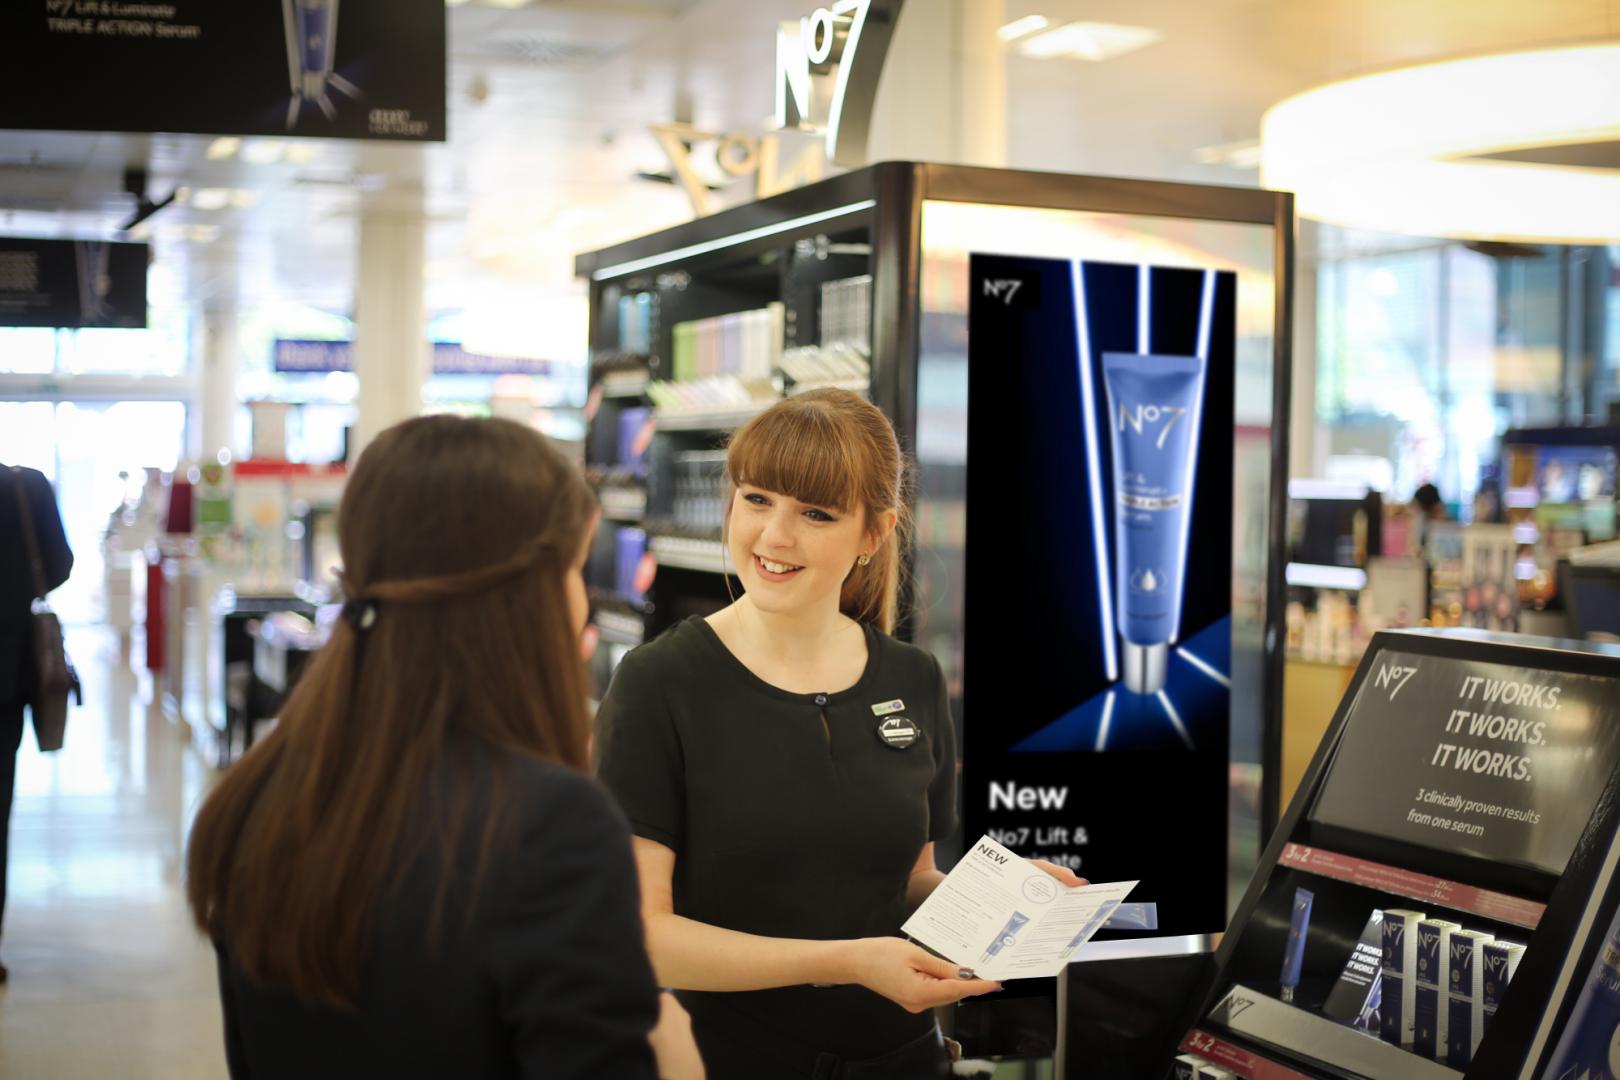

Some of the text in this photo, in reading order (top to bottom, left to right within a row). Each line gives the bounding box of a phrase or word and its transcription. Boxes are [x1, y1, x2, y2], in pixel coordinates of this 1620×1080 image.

[48, 17, 200, 38] TRIPLE ACTION Serum
[1459, 675, 1483, 699] IT
[1483, 679, 1562, 711] WORKS.
[1445, 709, 1547, 746] IT WORKS.
[1431, 743, 1532, 782] IT WORKS.
[989, 780, 1069, 811] New
[1415, 788, 1542, 825] 3 clinically proven results
[1035, 827, 1069, 846] Lift
[1073, 827, 1088, 845] &
[1407, 808, 1485, 837] from one serum
[977, 843, 1009, 866] NEW
